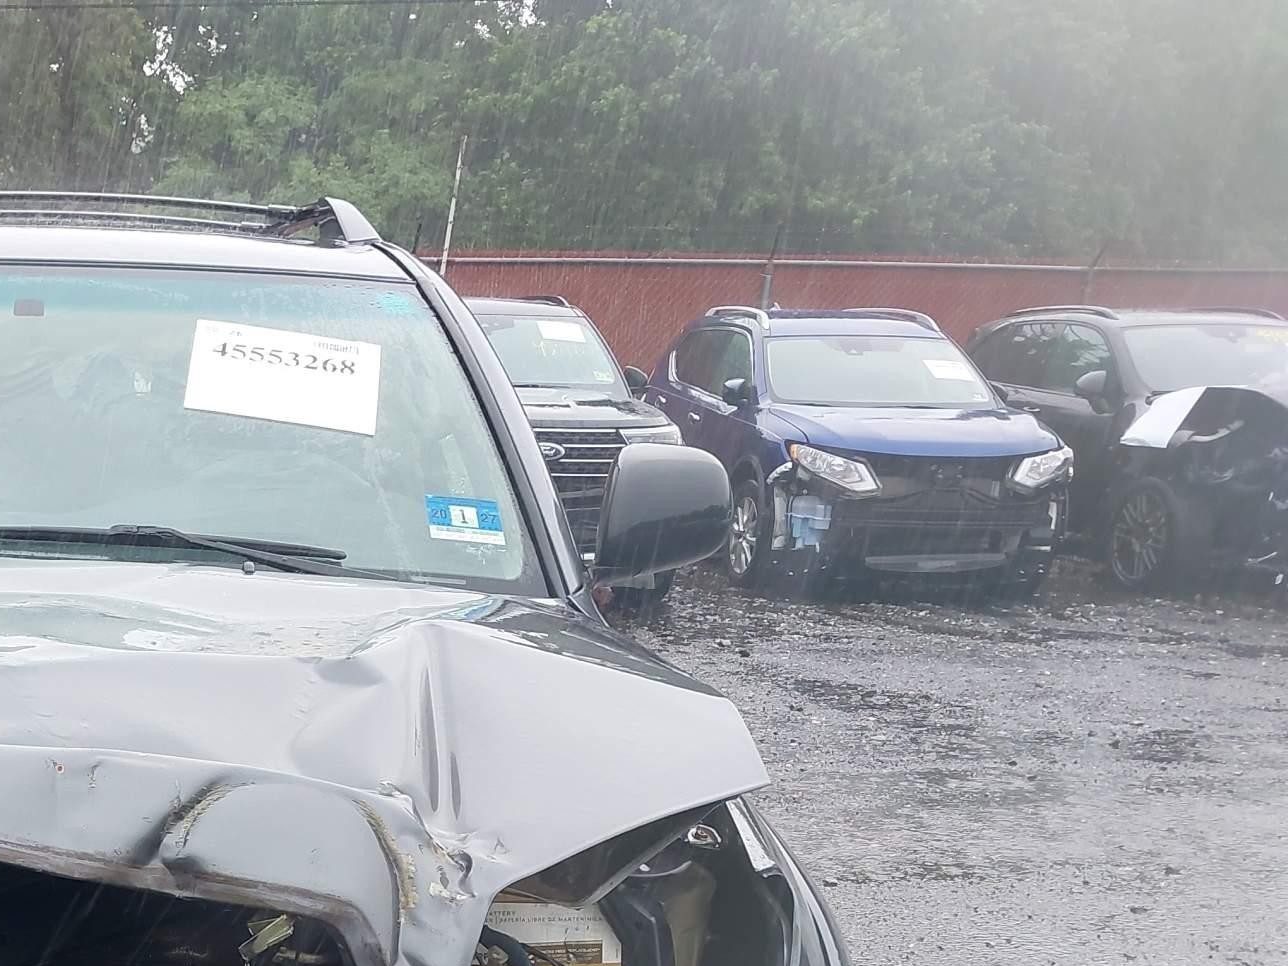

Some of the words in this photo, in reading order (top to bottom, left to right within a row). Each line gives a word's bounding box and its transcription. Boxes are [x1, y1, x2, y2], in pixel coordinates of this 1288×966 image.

[212, 341, 356, 375] 45553268
[431, 508, 448, 520] 20
[457, 508, 469, 524] 1
[480, 512, 498, 524] 27
